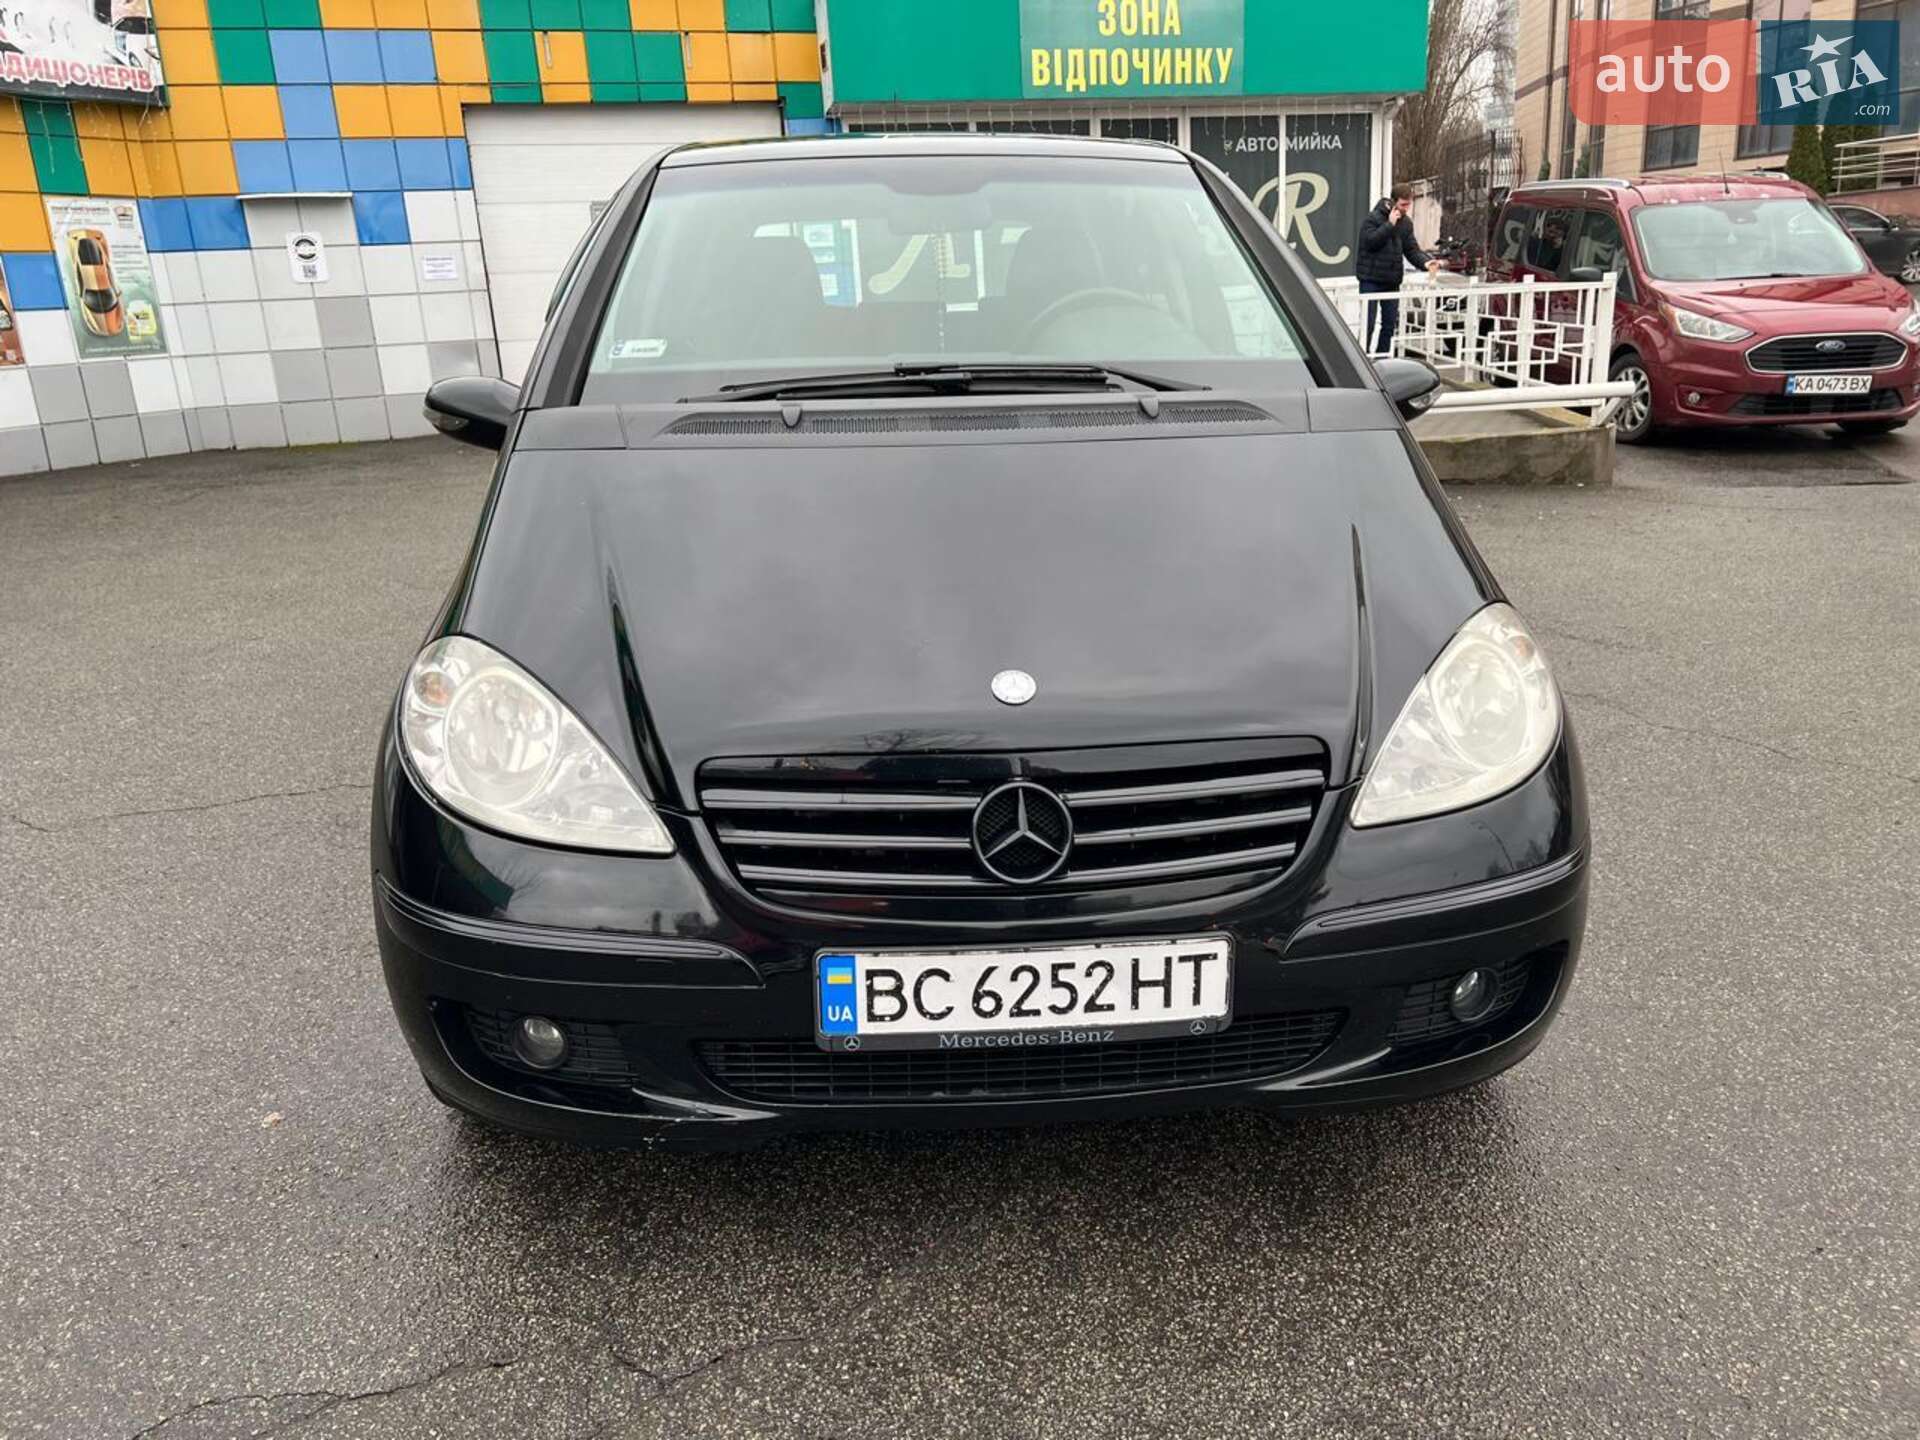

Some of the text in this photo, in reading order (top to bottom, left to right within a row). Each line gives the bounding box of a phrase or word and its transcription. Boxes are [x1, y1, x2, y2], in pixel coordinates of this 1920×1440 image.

[1098, 0, 1182, 36] ЗОНА
[0, 53, 153, 90] ДИЦІОНЕРІВ
[1031, 47, 1233, 92] ВІДПОЧИНКУ
[1816, 377, 1848, 391] 0473
[865, 952, 1219, 1023] BC 6252 HT
[827, 1005, 854, 1023] UA
[939, 1029, 1116, 1050] Mercedes-Benz
